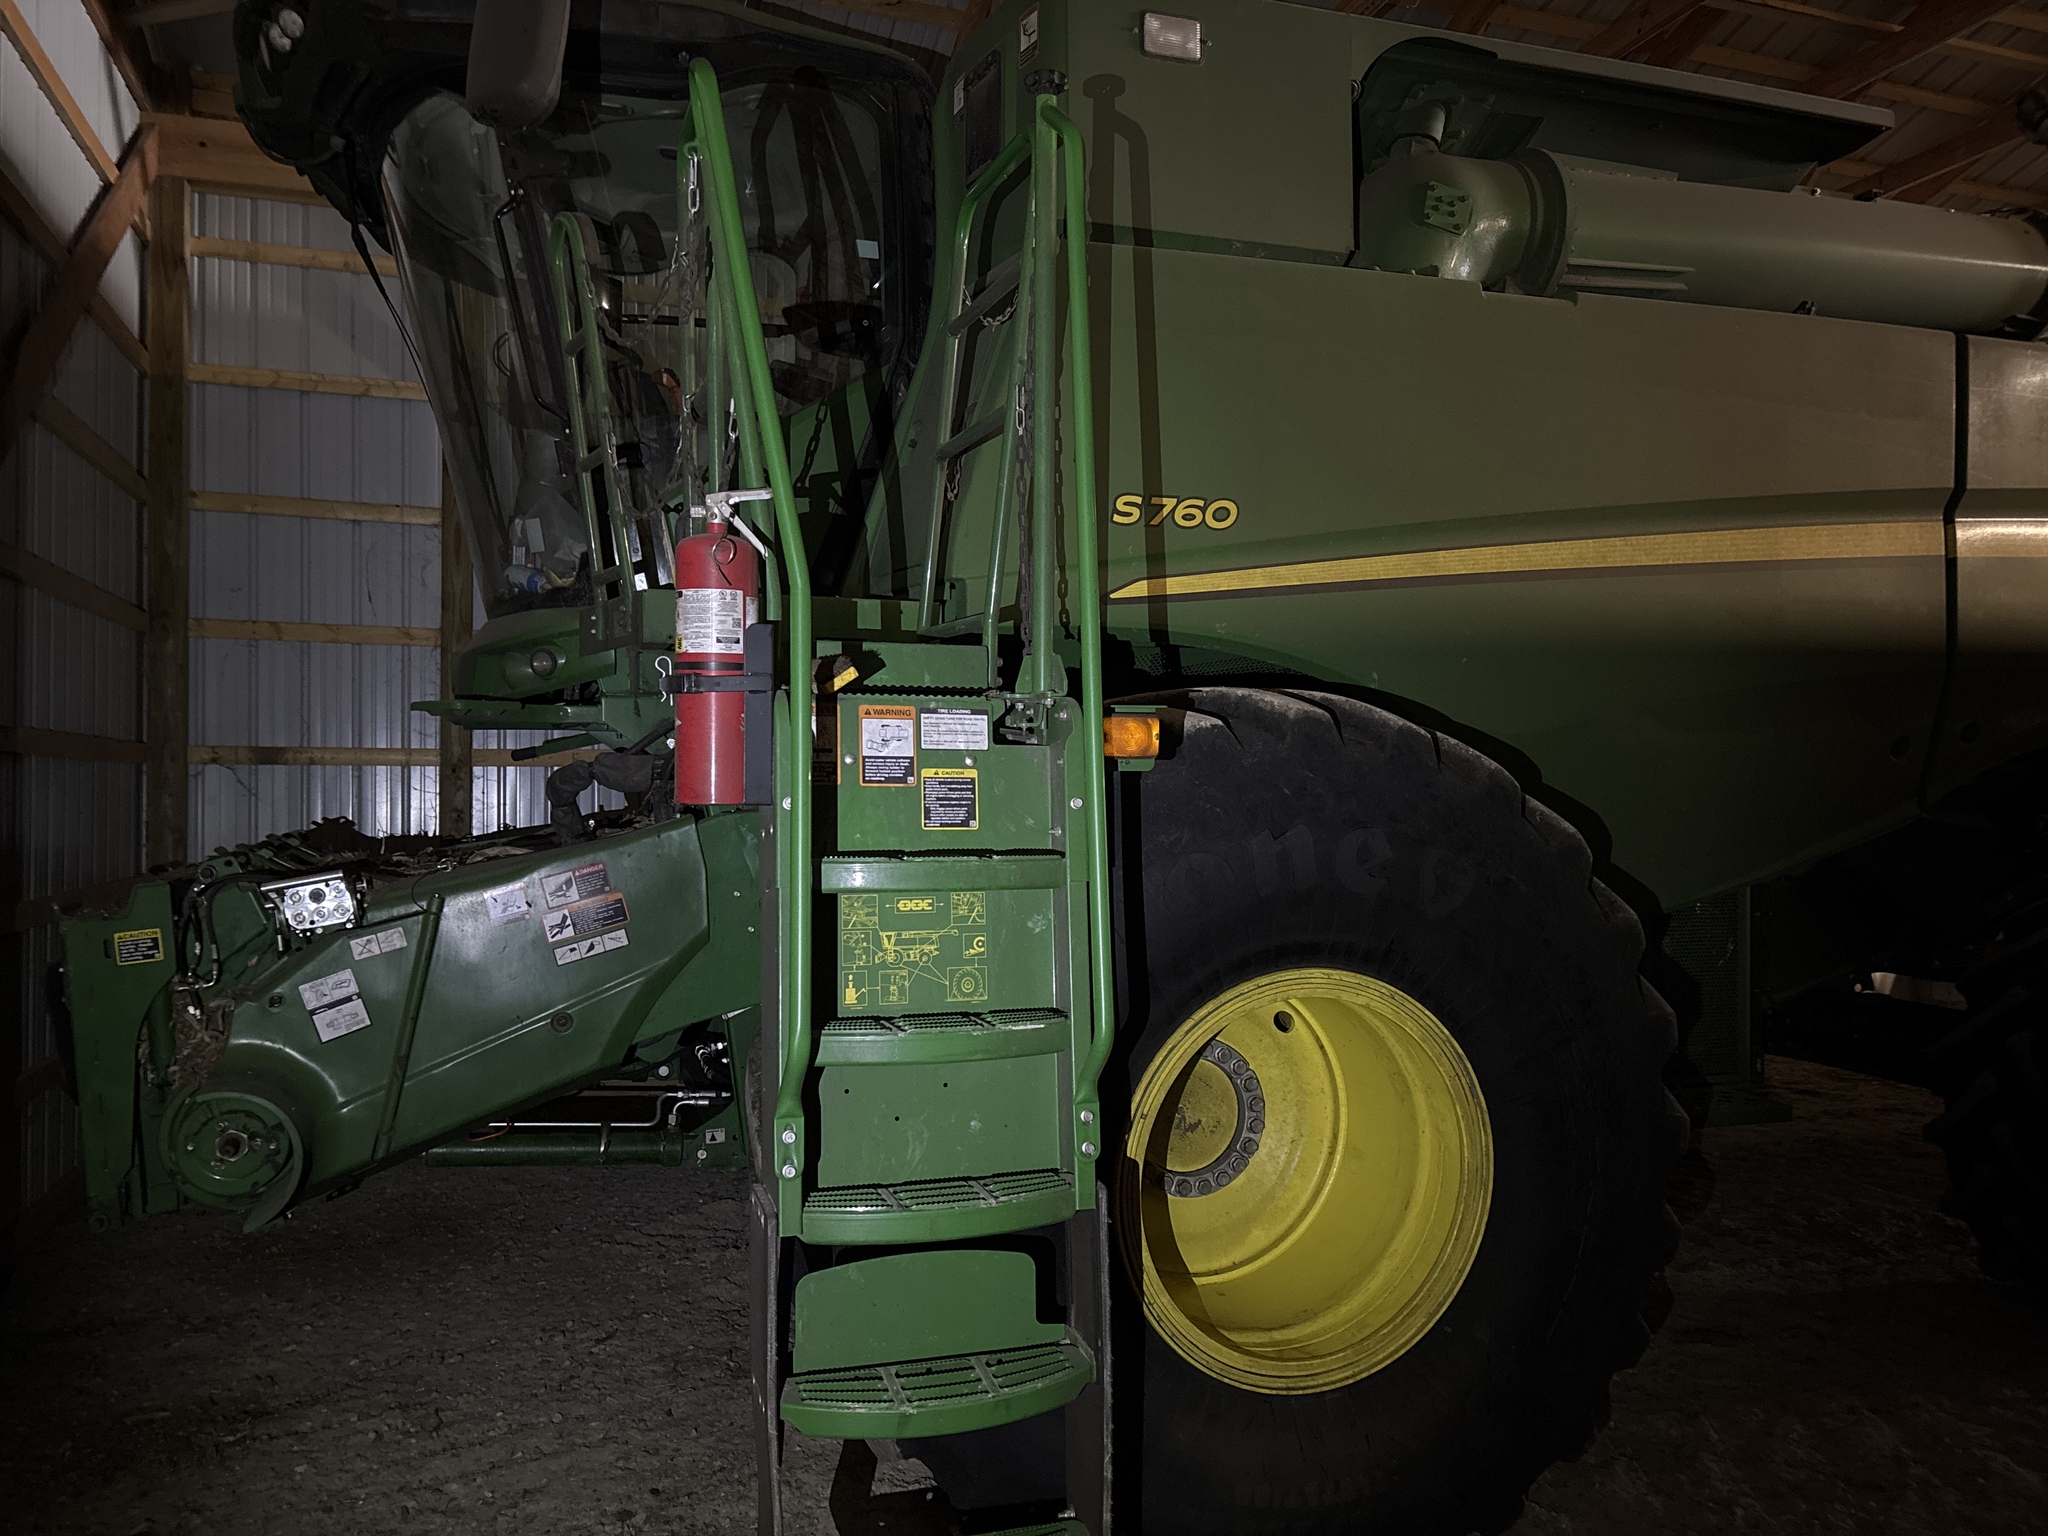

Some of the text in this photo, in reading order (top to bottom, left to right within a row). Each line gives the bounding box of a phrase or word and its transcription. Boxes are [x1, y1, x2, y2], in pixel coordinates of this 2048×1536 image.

[872, 708, 912, 716] WARNING
[580, 864, 603, 874] DANGER
[123, 930, 158, 940] CAUTION
